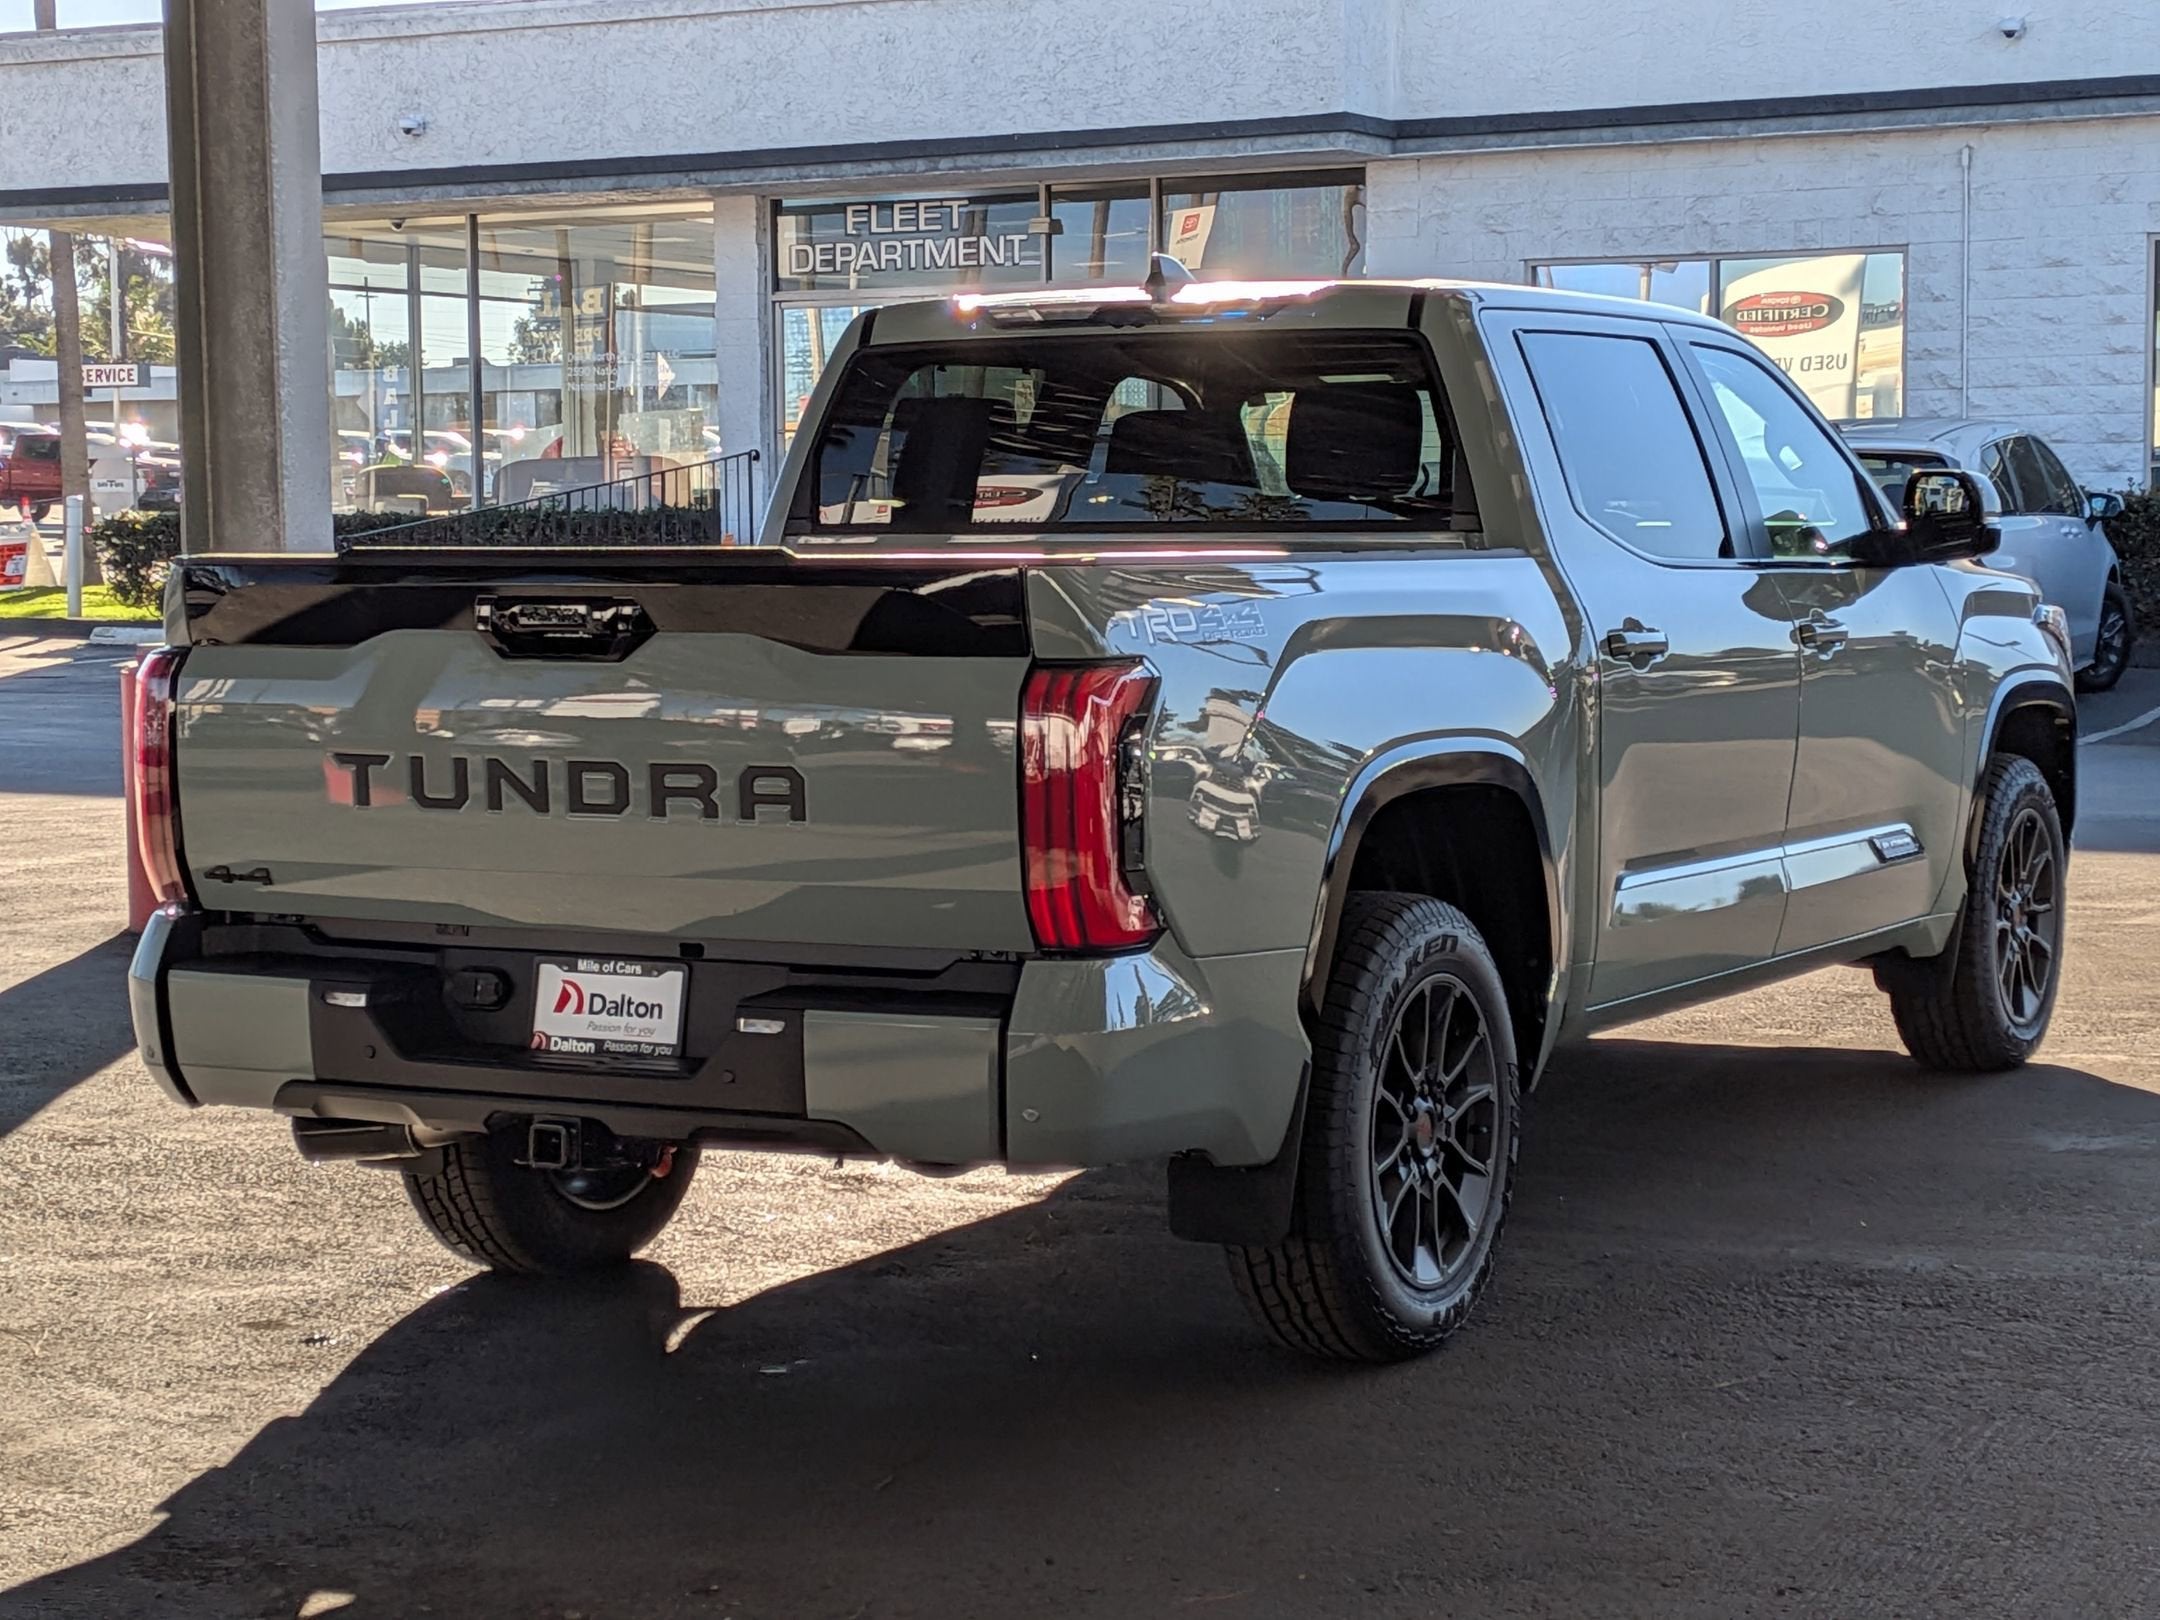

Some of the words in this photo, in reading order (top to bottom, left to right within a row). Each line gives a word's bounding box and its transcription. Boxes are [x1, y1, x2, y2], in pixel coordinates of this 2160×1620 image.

[845, 200, 969, 236] FLEET
[789, 234, 1028, 274] DEPARTMENT
[81, 368, 135, 383] ERVICE
[328, 752, 808, 825] TUNDRA
[577, 959, 600, 973] Mile
[602, 960, 614, 973] of
[616, 962, 642, 975] Cars
[588, 992, 663, 1019] Dalton
[586, 1021, 622, 1033] Passion
[623, 1023, 637, 1035] for
[637, 1027, 656, 1037] you
[550, 1036, 595, 1053] Dalton
[603, 1040, 639, 1052] Passion
[640, 1042, 653, 1054] for
[653, 1046, 673, 1056] you
